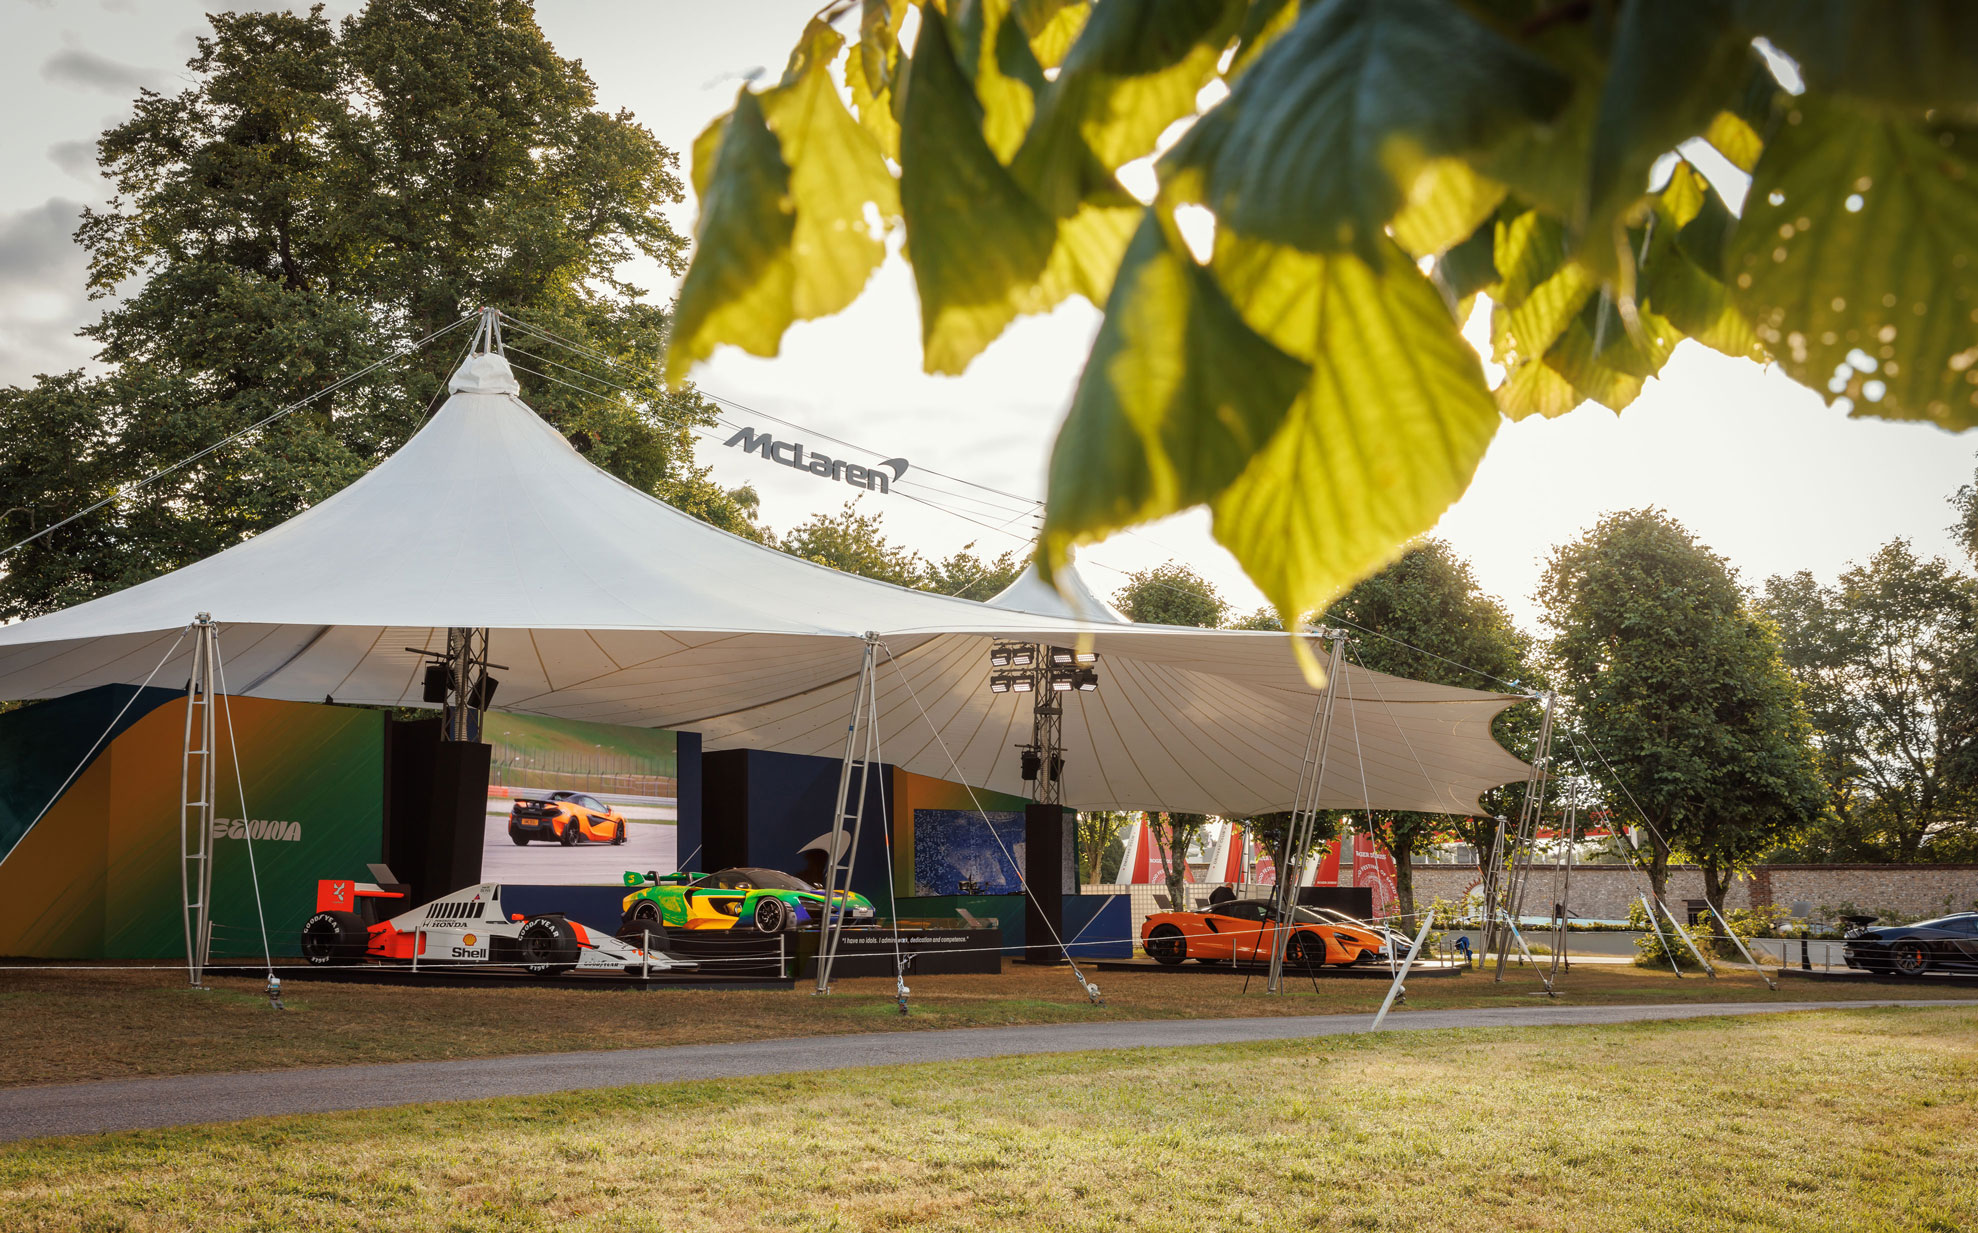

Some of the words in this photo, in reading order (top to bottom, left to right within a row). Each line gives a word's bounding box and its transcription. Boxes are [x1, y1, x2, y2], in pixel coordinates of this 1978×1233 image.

[722, 426, 889, 495] McLaren
[213, 818, 302, 842] SENNA
[303, 913, 340, 934] GOODYEAR
[517, 918, 560, 941] GOODYEAR
[311, 955, 330, 964] EAGLE
[451, 946, 487, 959] Shell
